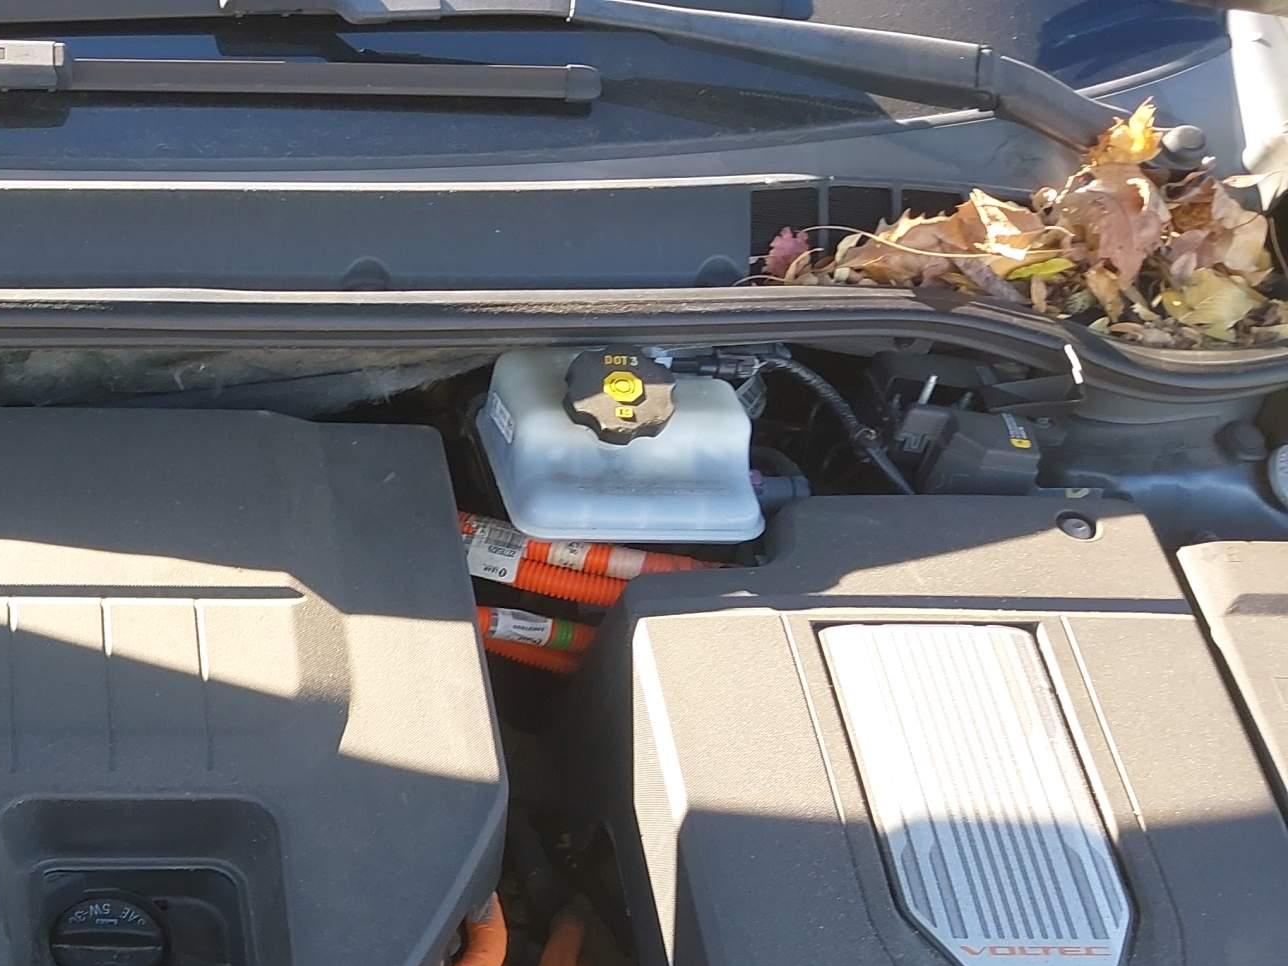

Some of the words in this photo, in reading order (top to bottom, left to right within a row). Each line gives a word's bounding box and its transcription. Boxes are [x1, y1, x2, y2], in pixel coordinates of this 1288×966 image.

[603, 355, 628, 366] DOT
[630, 355, 639, 366] 3
[960, 946, 1113, 956] VOLTEC
